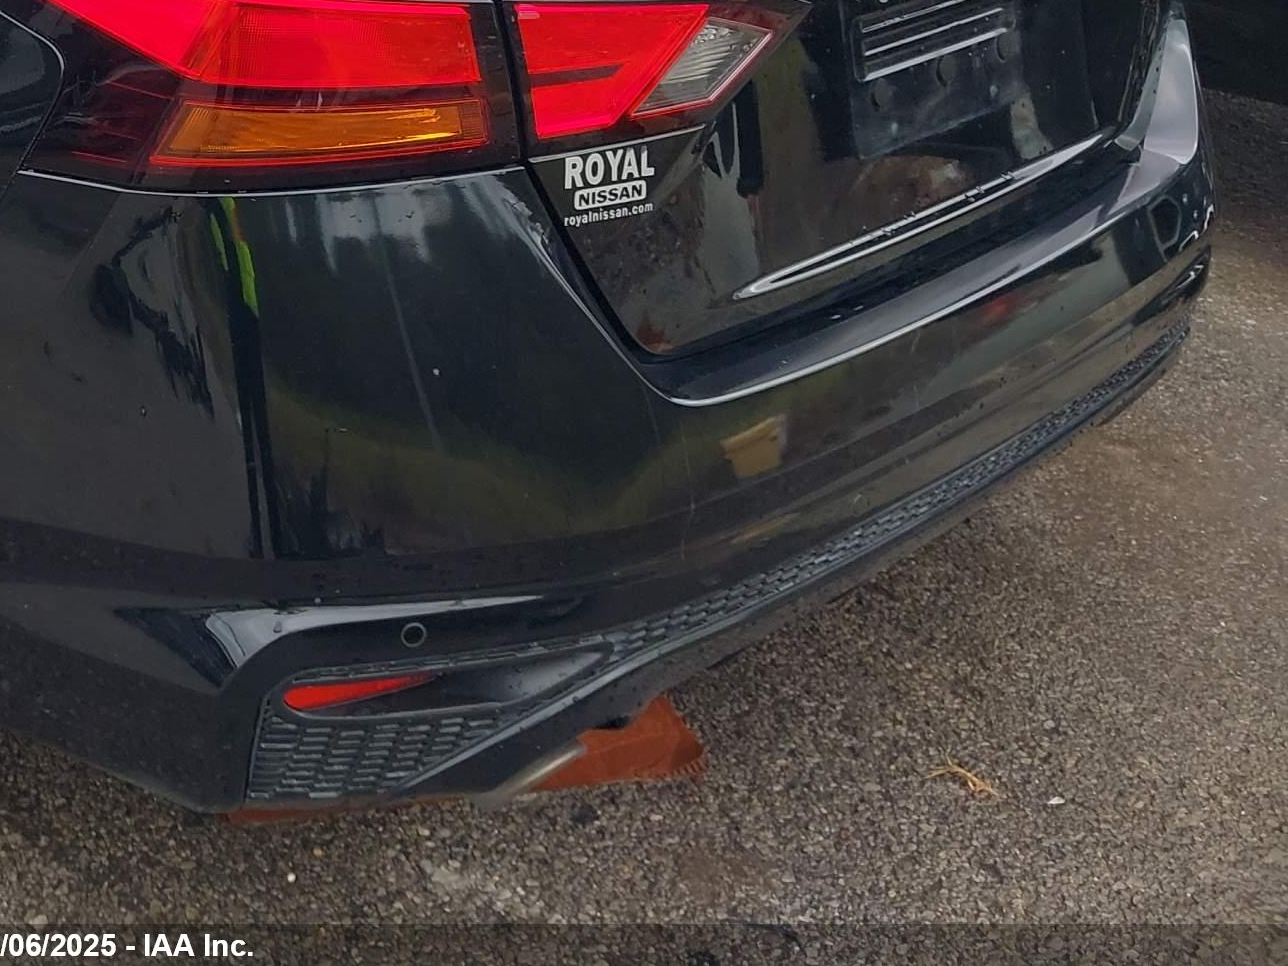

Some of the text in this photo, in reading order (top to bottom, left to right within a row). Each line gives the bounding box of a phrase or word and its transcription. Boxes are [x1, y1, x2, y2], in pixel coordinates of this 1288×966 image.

[564, 145, 655, 190] ROYAL
[578, 183, 643, 207] NISSAN
[563, 203, 654, 228] royalnissan.com
